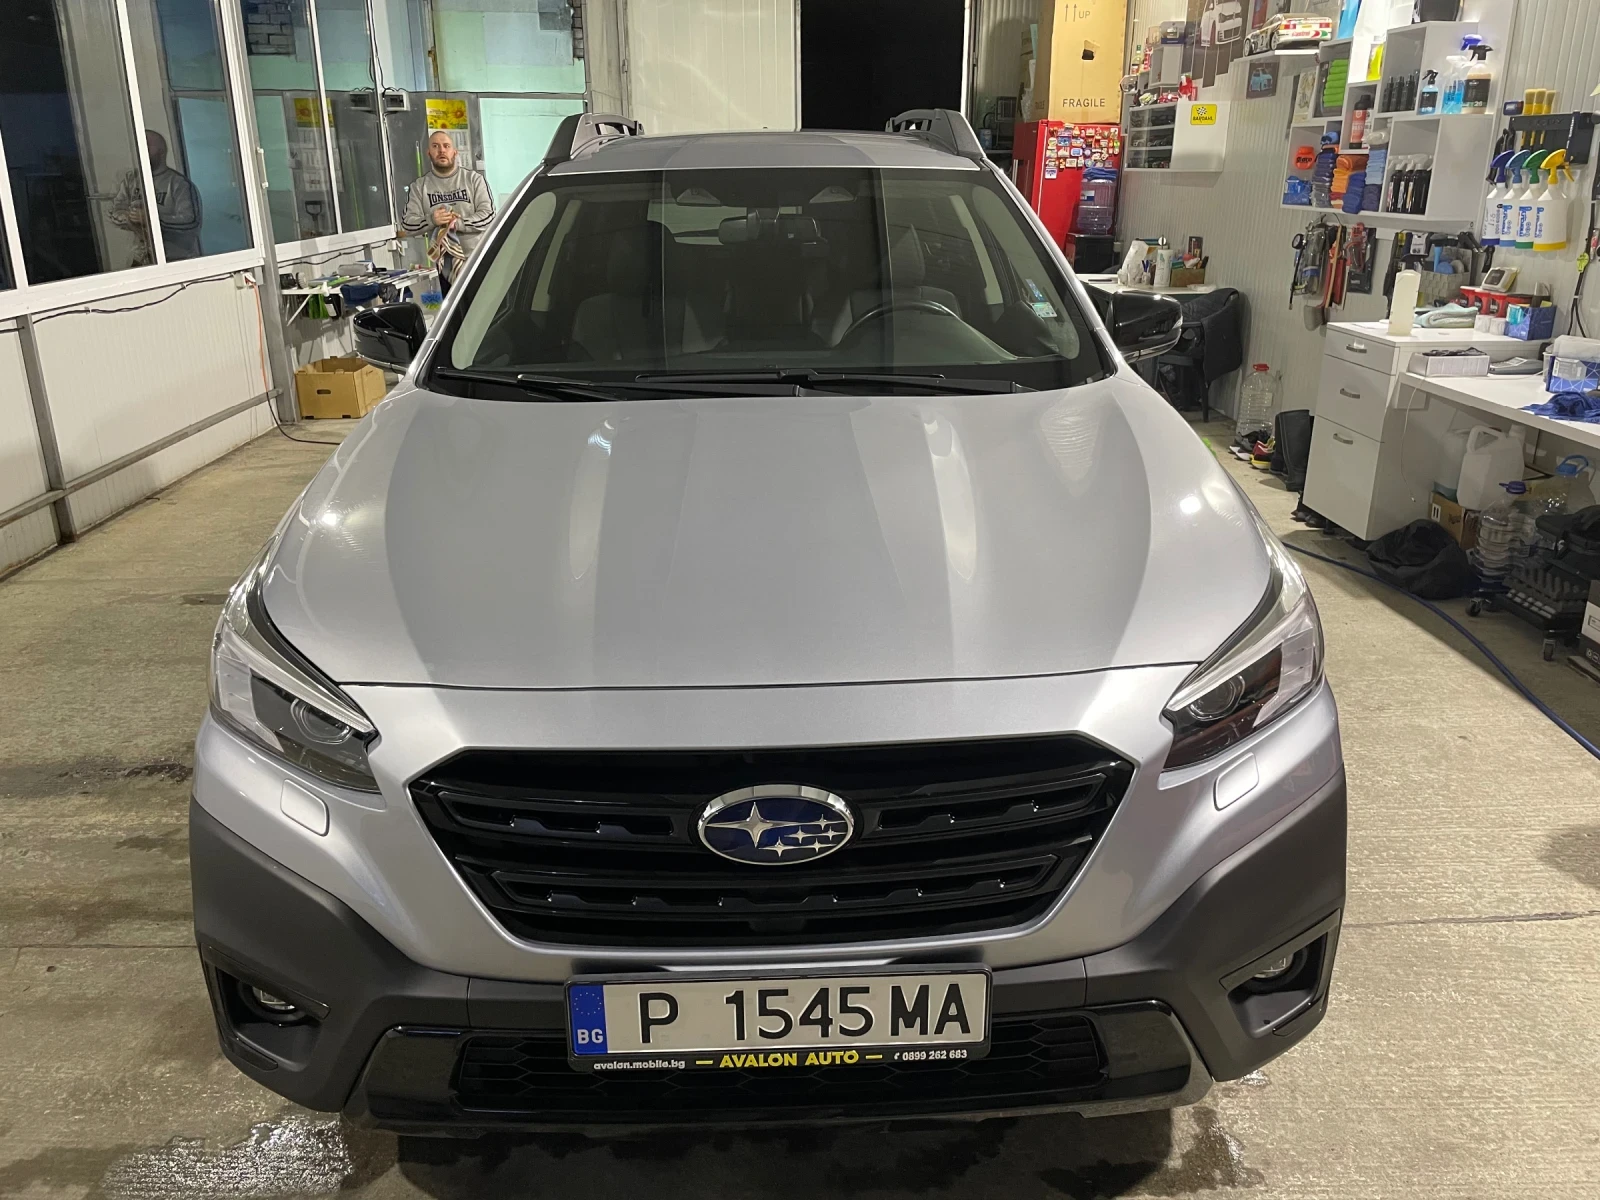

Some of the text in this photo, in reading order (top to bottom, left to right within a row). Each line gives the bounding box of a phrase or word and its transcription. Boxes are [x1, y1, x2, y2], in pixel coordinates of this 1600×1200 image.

[1078, 11, 1091, 19] UP
[1062, 98, 1106, 108] FRAGILE
[427, 189, 471, 208] LONSDALE
[640, 983, 971, 1044] P 1545 MA
[577, 1028, 604, 1044] BG
[593, 1049, 968, 1071] avalon.mobile.bg AVALON AUTO 0899 262 683
